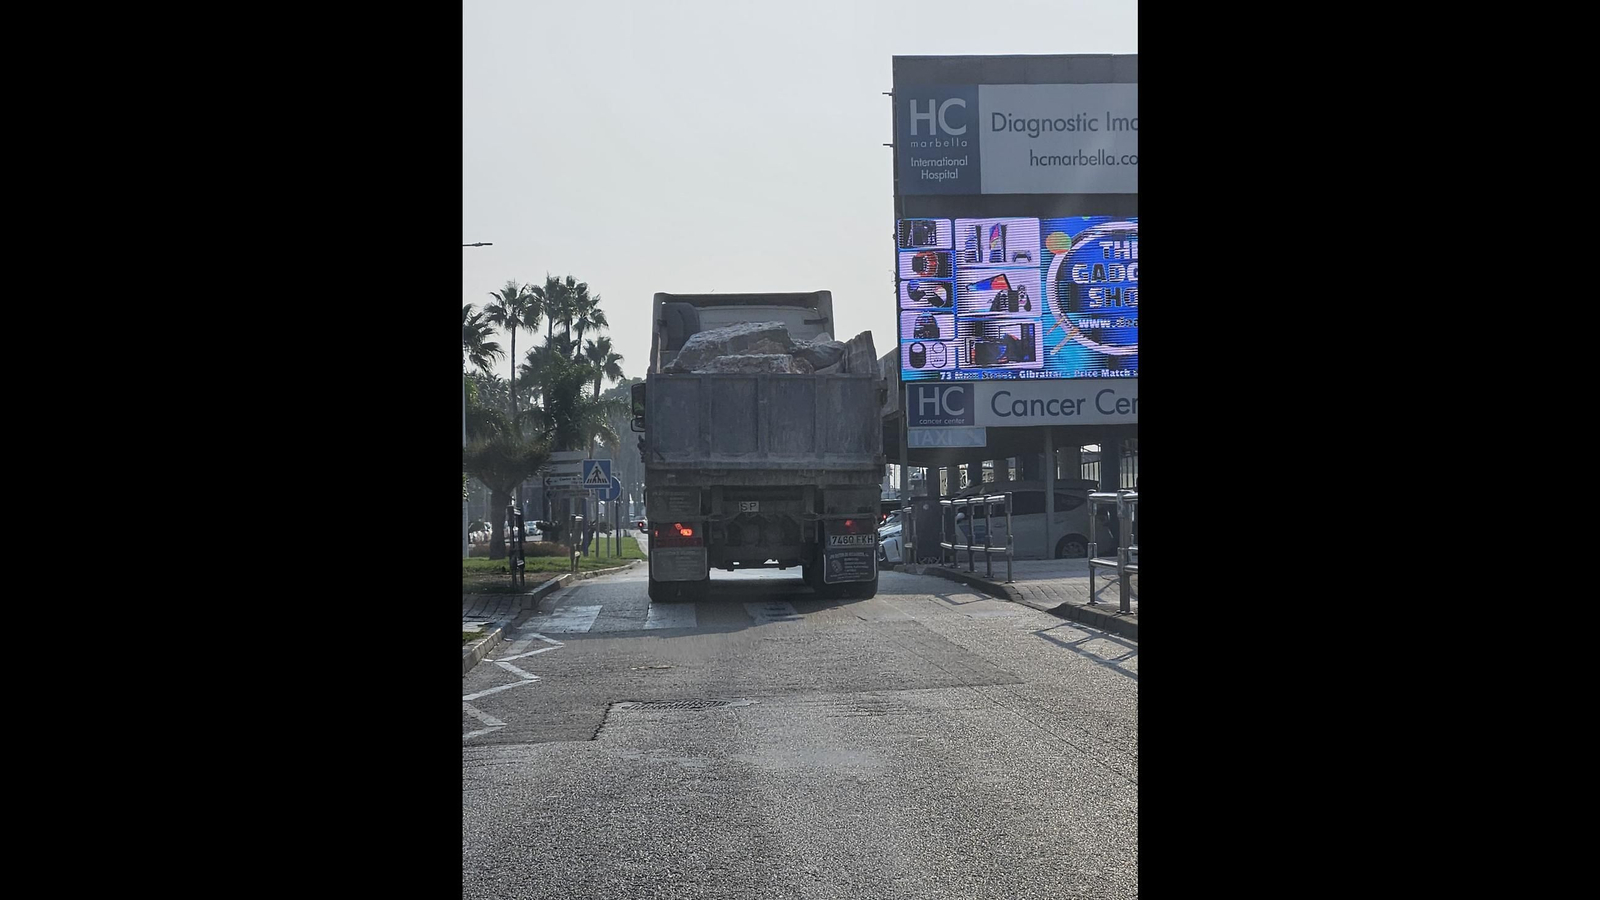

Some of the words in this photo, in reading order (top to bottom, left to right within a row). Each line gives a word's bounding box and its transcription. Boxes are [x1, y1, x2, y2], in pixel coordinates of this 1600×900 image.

[910, 98, 967, 135] HC
[992, 112, 1098, 138] Diagnostic
[911, 137, 968, 148] marbella
[910, 155, 968, 167] International
[921, 169, 958, 182] Hospital
[939, 371, 952, 380] 73
[918, 386, 964, 416] HC
[991, 390, 1085, 417] Cancer
[944, 417, 965, 425] center
[911, 430, 952, 446] TAXI
